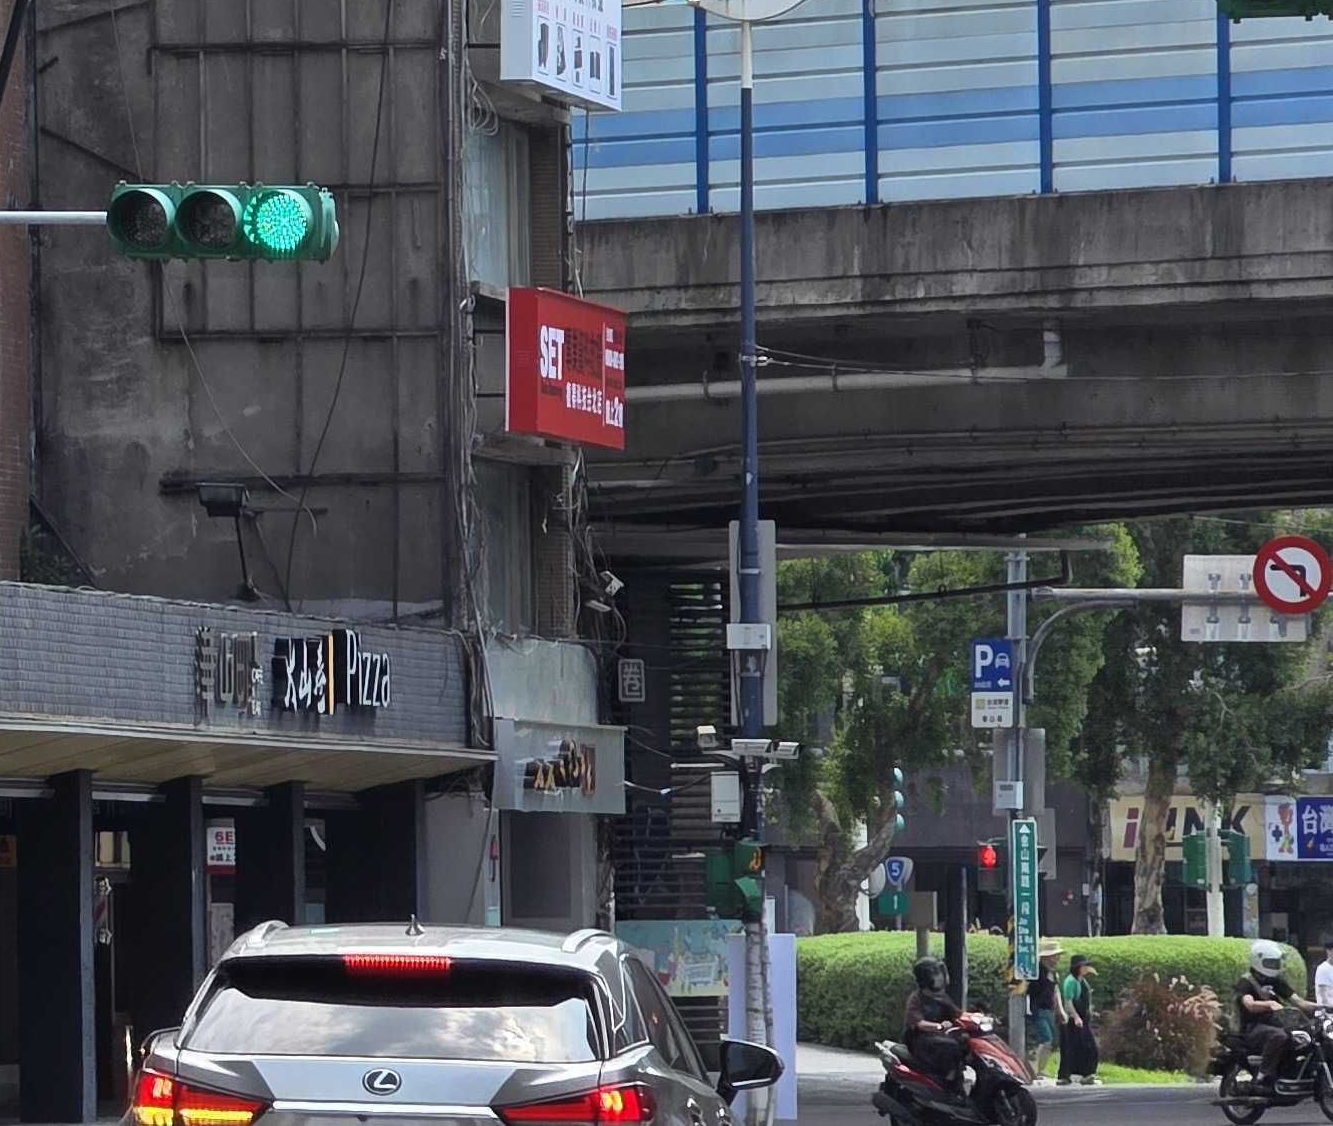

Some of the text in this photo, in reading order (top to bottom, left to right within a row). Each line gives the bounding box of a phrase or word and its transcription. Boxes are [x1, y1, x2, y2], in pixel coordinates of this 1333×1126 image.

[540, 325, 565, 381] SET
[346, 628, 391, 708] Pizza
[974, 644, 994, 678] P
